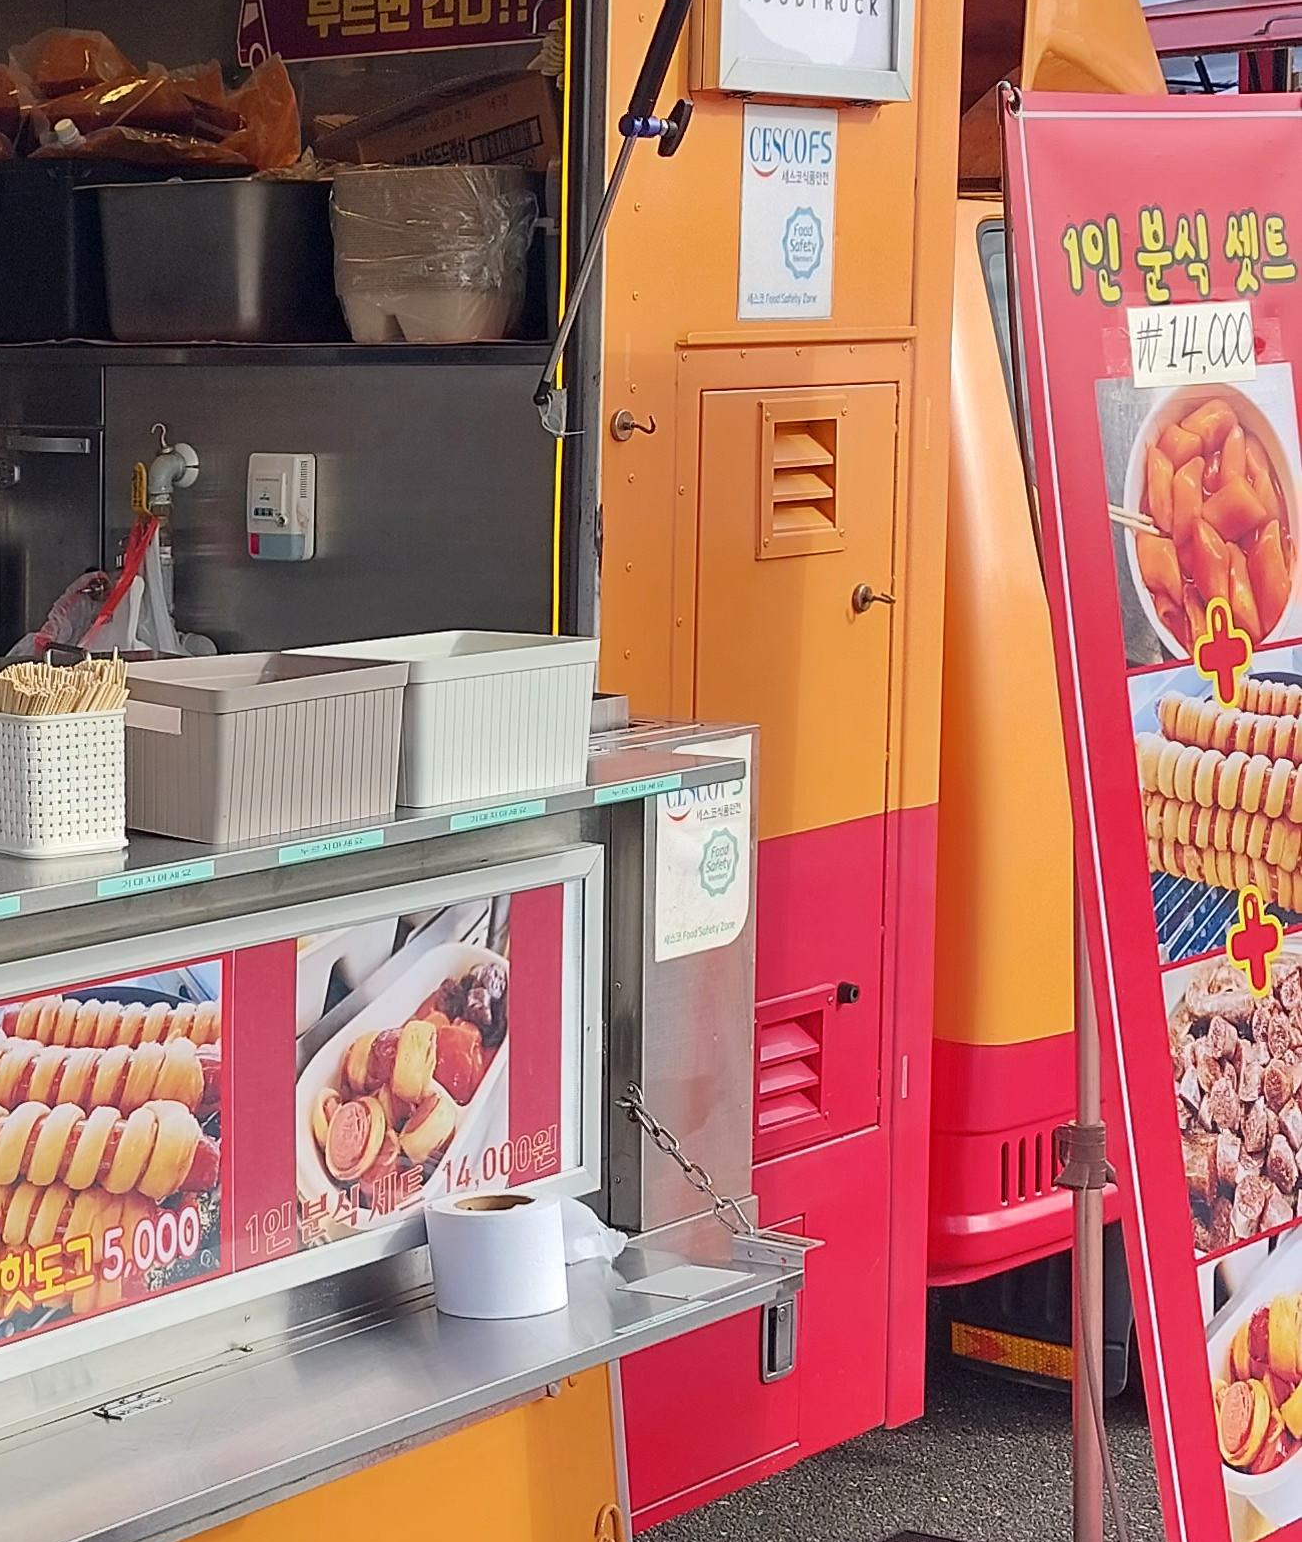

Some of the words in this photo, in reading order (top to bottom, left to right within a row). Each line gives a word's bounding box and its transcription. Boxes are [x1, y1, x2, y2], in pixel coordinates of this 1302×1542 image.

[793, 222, 814, 238] Food
[789, 237, 818, 257] Safety
[1062, 213, 1123, 303] 1인
[1135, 207, 1210, 304] 분식
[1224, 209, 1298, 293] 셋트
[710, 842, 731, 859] Food
[705, 857, 732, 875] Safety
[245, 1200, 292, 1256] 1인
[298, 1183, 362, 1246] 분식
[369, 1163, 426, 1223] 세트
[443, 1123, 559, 1195] 14,000원
[102, 1205, 201, 1281] 5,000
